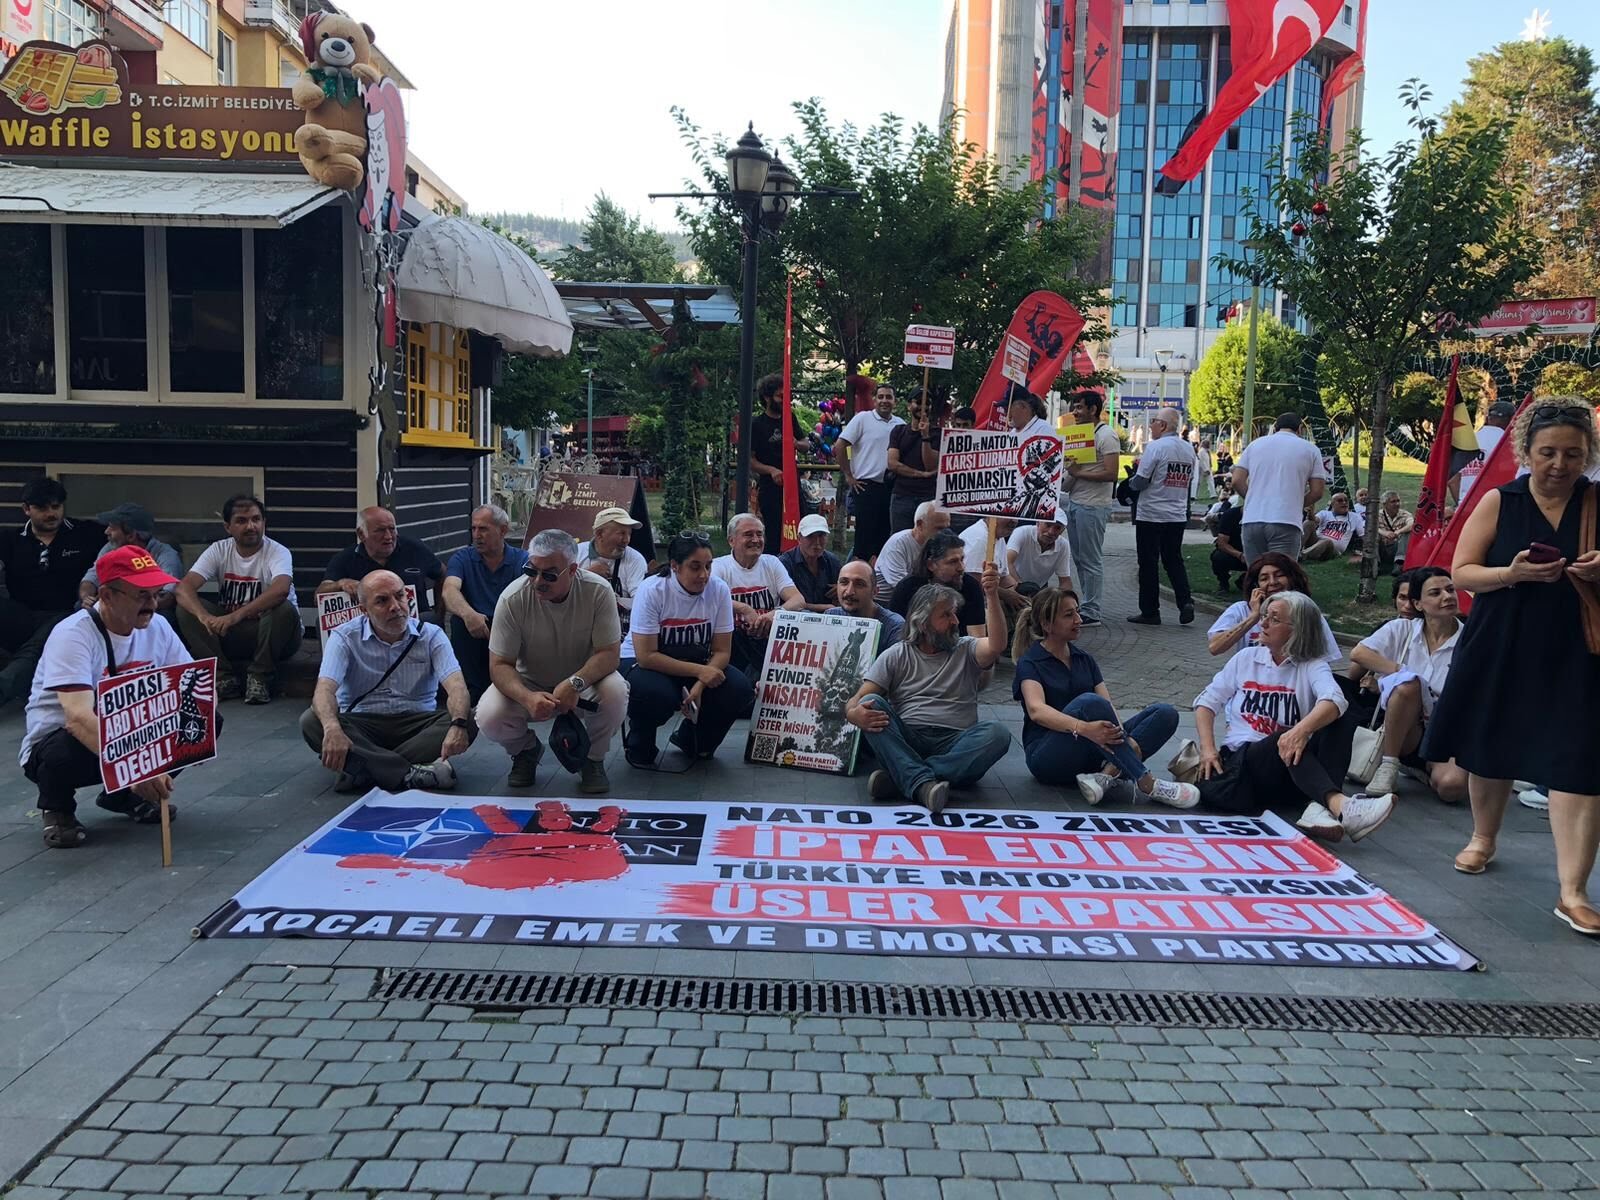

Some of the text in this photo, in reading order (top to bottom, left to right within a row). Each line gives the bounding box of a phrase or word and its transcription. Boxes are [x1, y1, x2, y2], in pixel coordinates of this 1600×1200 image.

[224, 95, 305, 111] BELEDİYES
[0, 111, 298, 160] Waffle İstasyonu
[947, 435, 972, 453] ABD
[981, 434, 1018, 450] NATO'YA
[946, 449, 1018, 471] KARŞI DURMAK
[577, 482, 592, 490] T.C.
[946, 468, 1017, 491] MONARŞİYE
[573, 498, 616, 509] BELEDİYESİ
[574, 490, 597, 498] İZMİT
[946, 488, 1012, 503] KARŞI DURMAKTIR!
[132, 555, 157, 570] BE
[324, 597, 344, 613] ABD
[775, 624, 799, 640] BİR
[770, 640, 828, 668] KATİLİ
[767, 667, 812, 685] EVİNDE
[103, 672, 162, 715] BURASI
[762, 684, 821, 709] MİSAFİR
[105, 690, 178, 741] ABD VE NATO
[760, 707, 789, 719] ETMEK
[107, 713, 180, 761] CUMHURİYETİ
[757, 718, 815, 736] İSTER MİSİN?
[115, 738, 173, 786] DEĞİL!
[571, 816, 688, 831] NTO
[727, 806, 1281, 837] NATO 2026 ZİRVESİ
[753, 824, 1318, 873] İPTAL EDİLSİN!
[713, 862, 1369, 896] TÜRKİYE NATO'DAN ÇIKSIN
[711, 884, 1417, 933] ÜSLER KAPATILSIN!
[229, 912, 1461, 965] KOCAELİ EMEK VE DEMOKRASİ PLATFORMU
